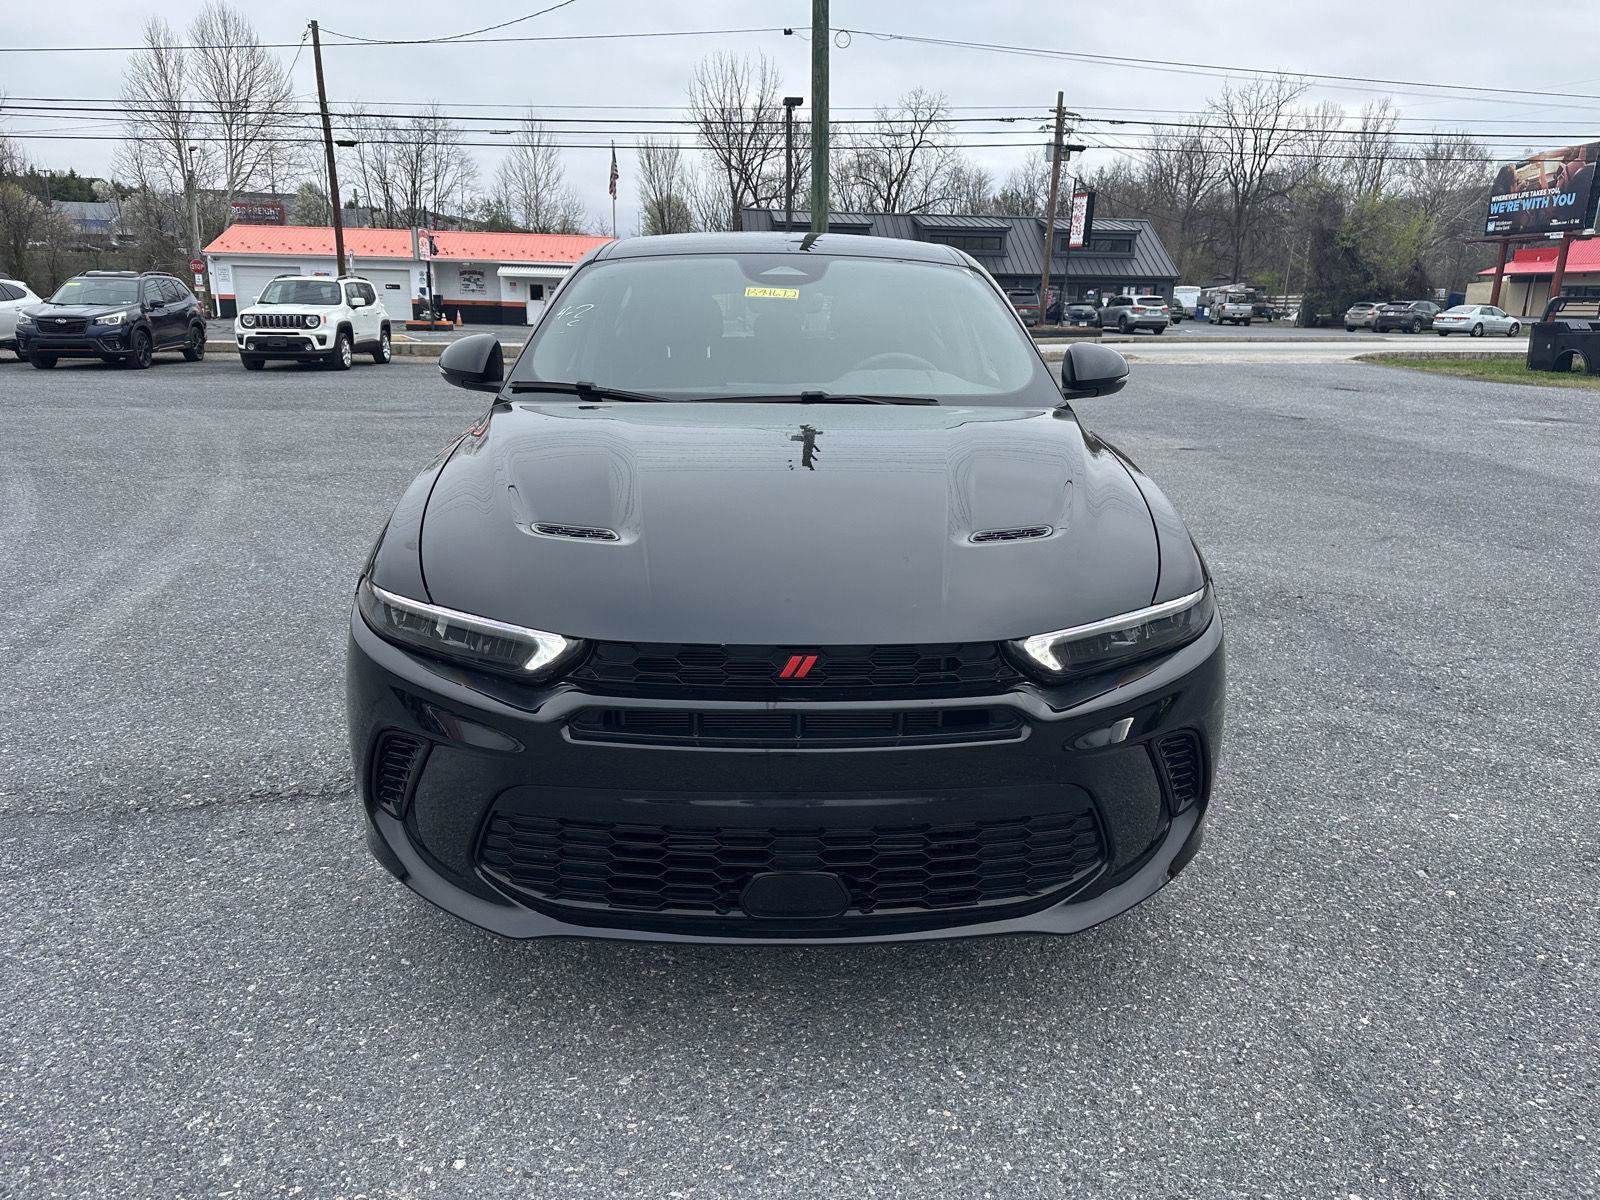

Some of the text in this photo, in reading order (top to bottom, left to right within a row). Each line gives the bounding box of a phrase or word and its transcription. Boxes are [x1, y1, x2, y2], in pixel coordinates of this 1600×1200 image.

[1490, 192, 1576, 214] WE'RE WITH YOU
[1491, 193, 1518, 202] WHEREVER
[1518, 191, 1530, 199] LIFE
[1530, 189, 1547, 197] TAKES
